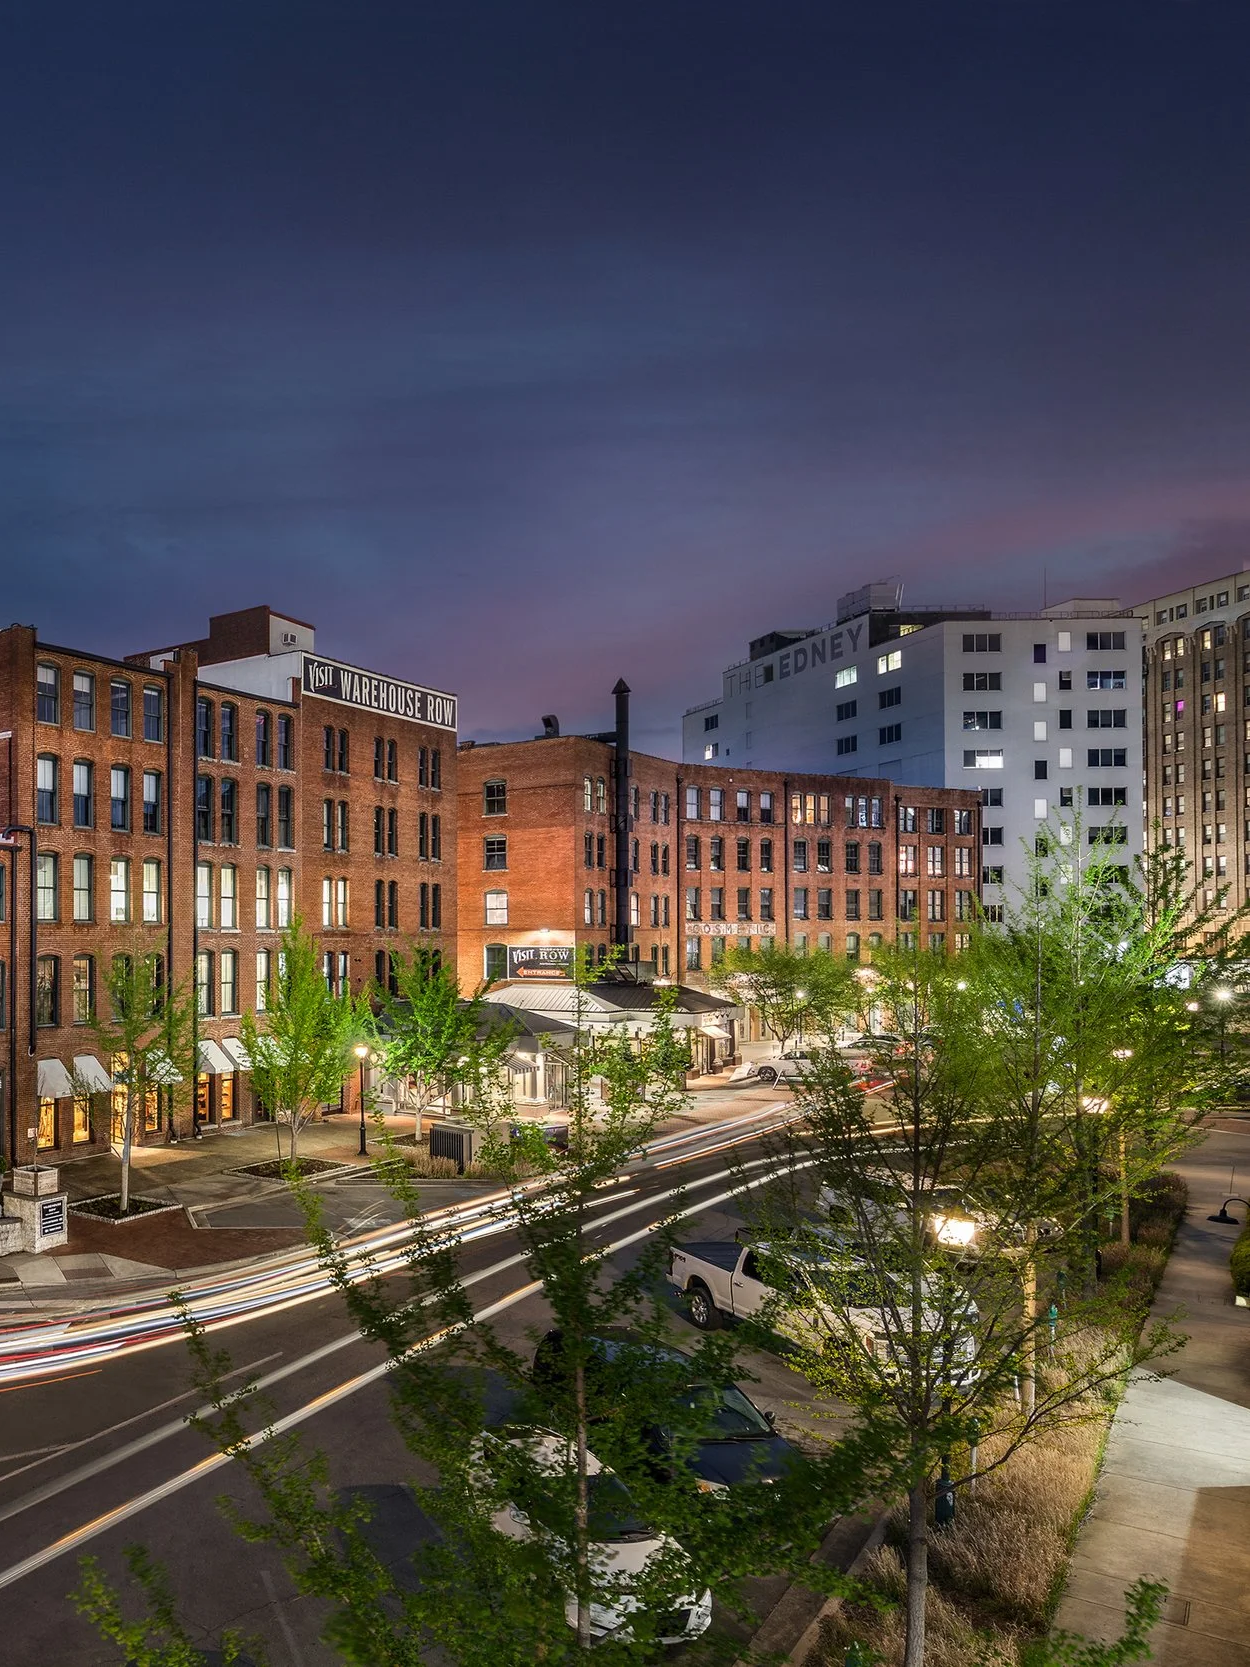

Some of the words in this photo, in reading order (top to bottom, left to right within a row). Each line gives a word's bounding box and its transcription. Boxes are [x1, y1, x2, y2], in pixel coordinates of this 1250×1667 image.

[779, 623, 864, 680] EDNEY
[308, 661, 335, 693] VISIT
[340, 670, 422, 719] WAREHOUSE
[427, 694, 454, 726] ROW
[512, 949, 535, 965] VISIT
[539, 951, 570, 960] ROW
